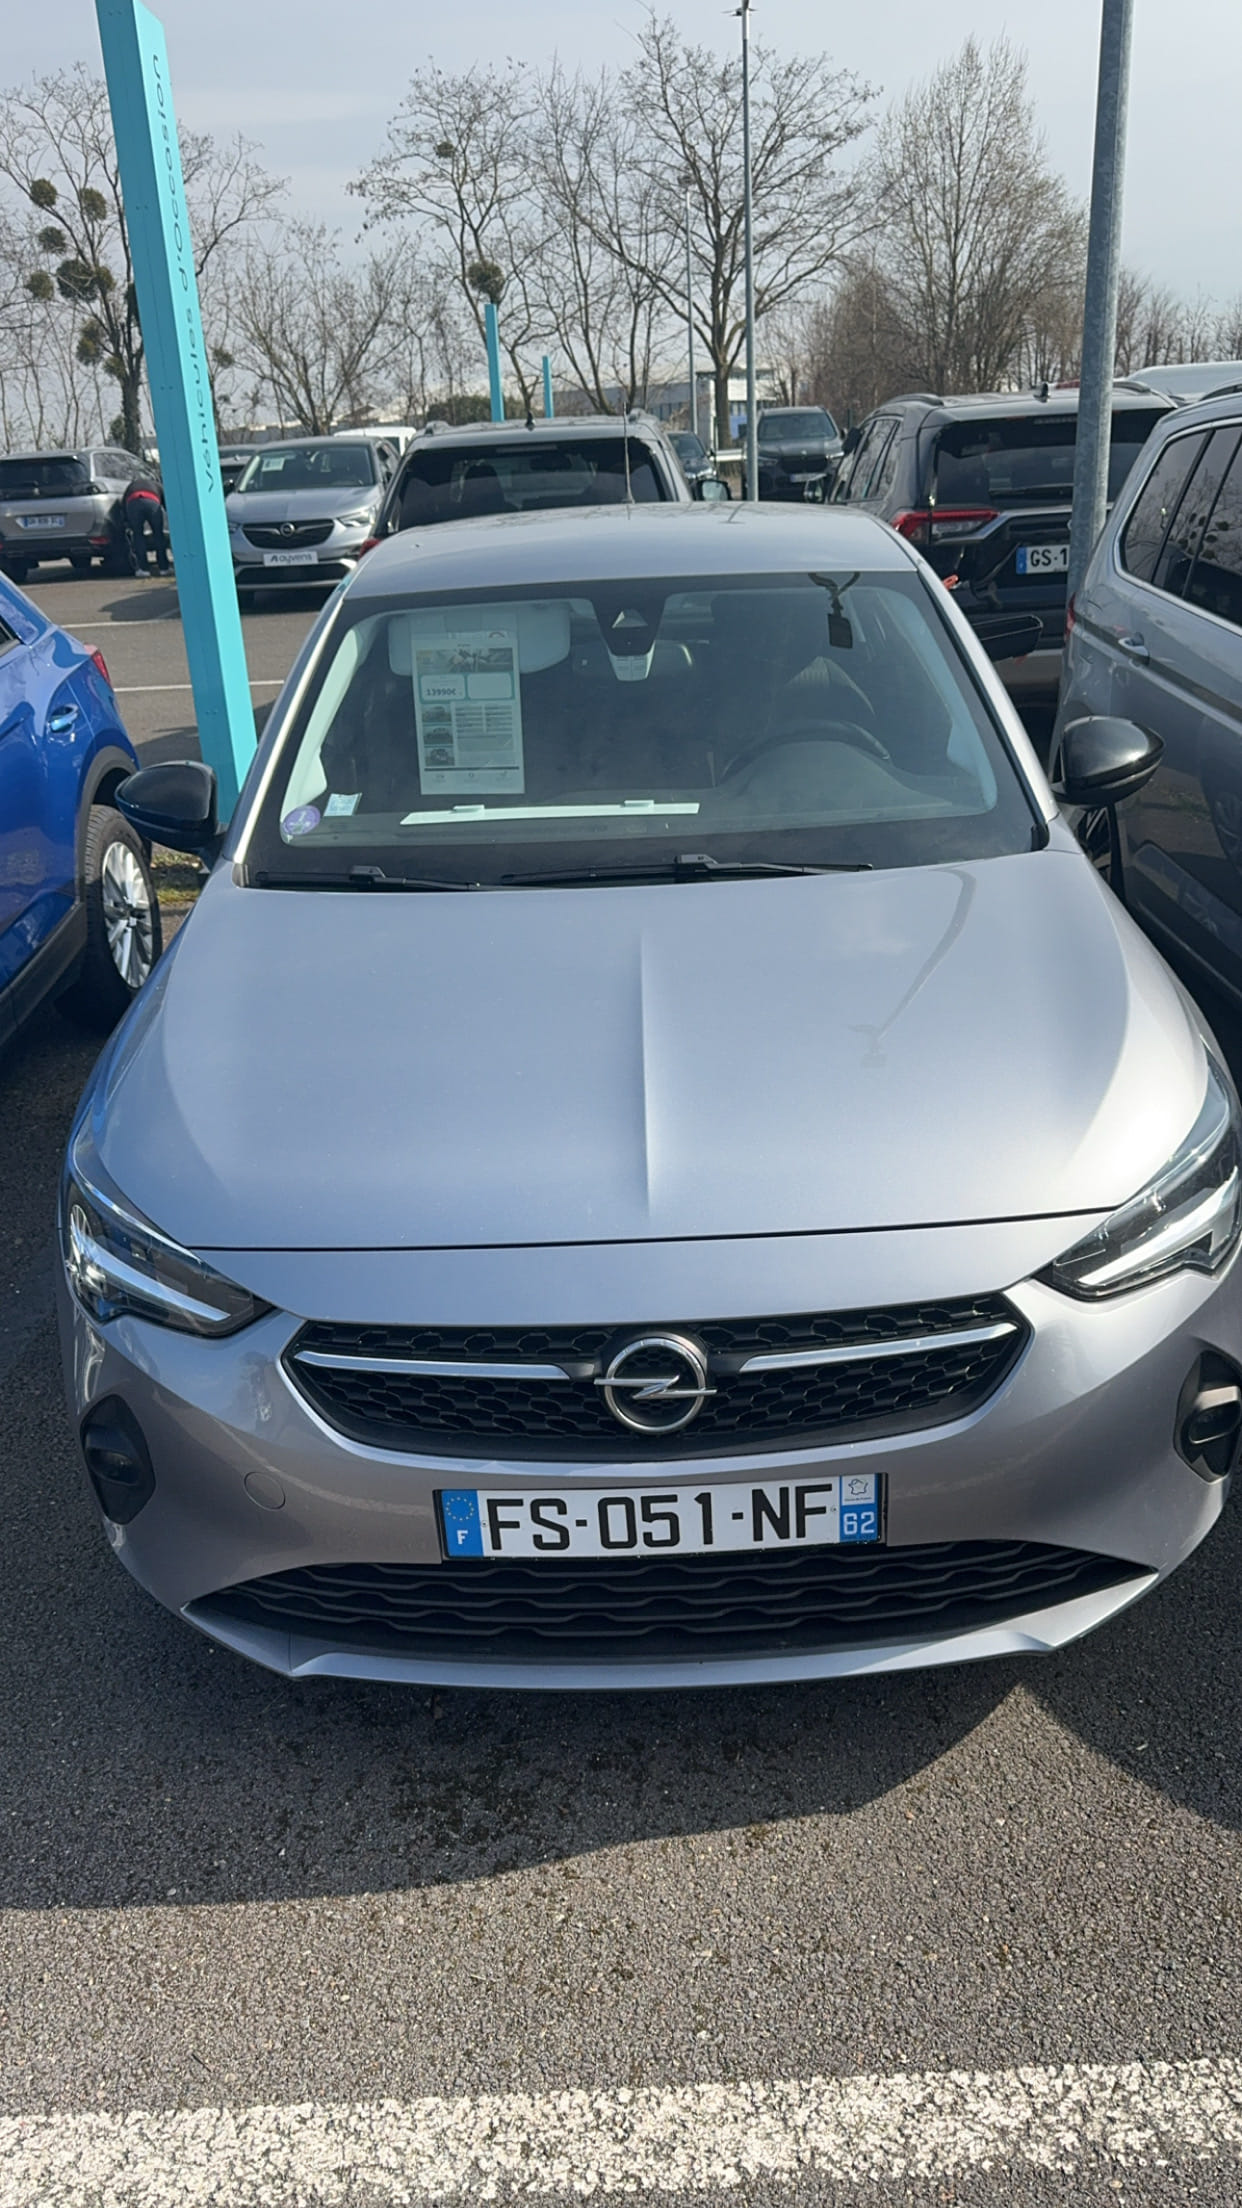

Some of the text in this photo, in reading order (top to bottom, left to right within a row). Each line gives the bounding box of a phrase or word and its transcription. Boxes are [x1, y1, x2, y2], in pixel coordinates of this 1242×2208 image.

[457, 1484, 875, 1551] F FS-051-NF 62
